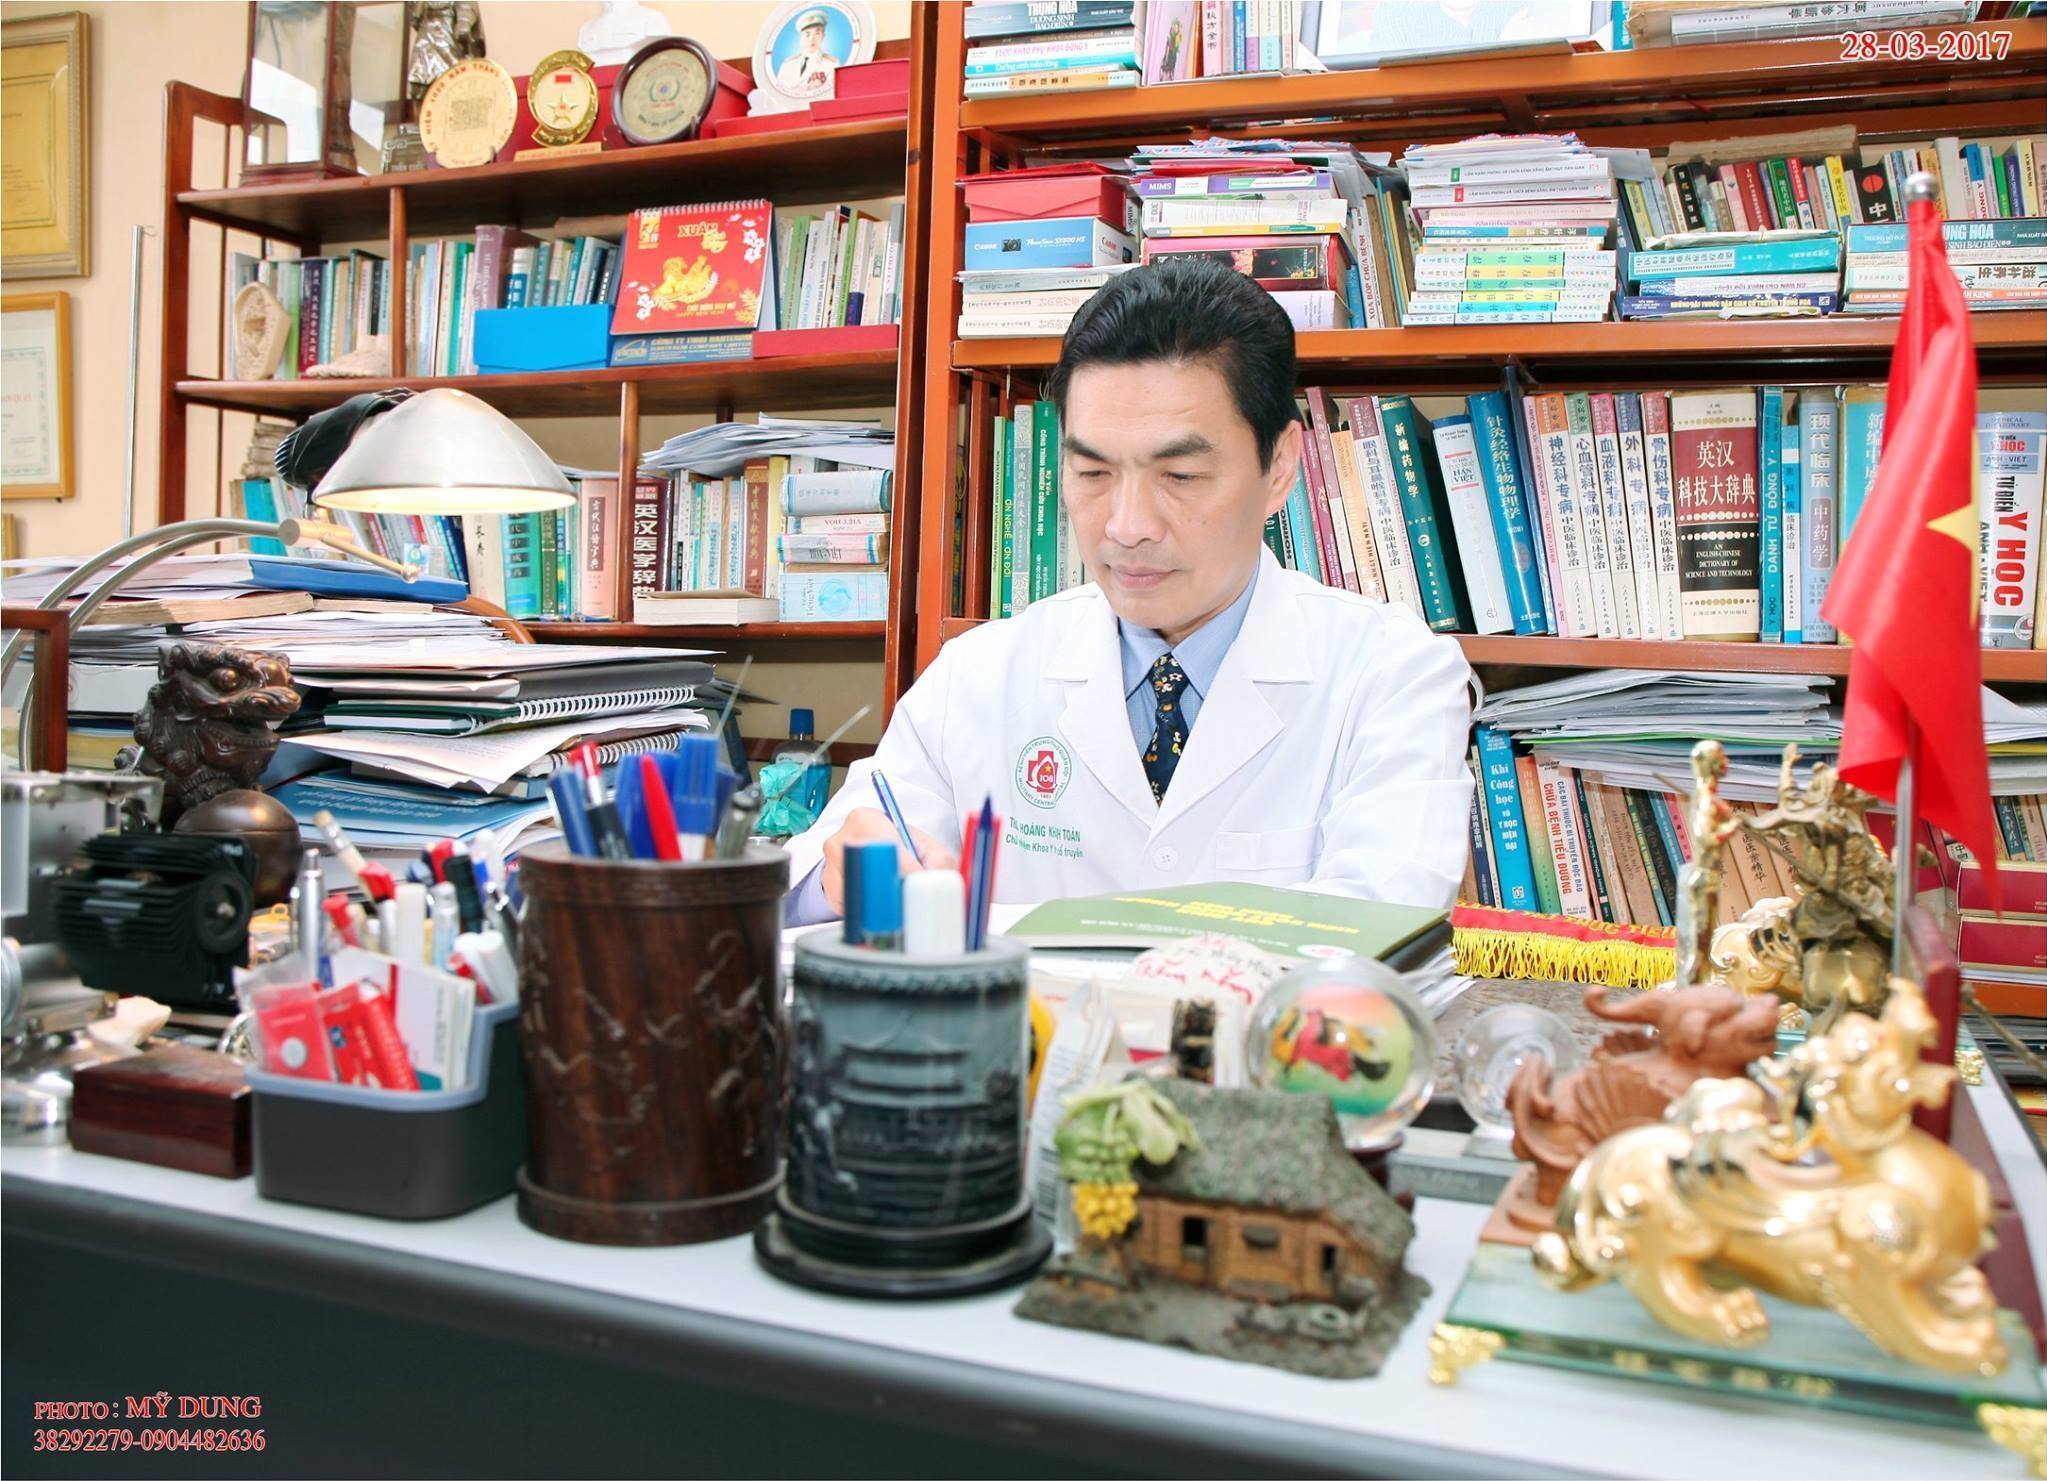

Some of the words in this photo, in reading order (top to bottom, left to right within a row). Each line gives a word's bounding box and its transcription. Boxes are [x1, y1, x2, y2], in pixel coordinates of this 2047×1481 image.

[1028, 2, 1057, 17] TRUNG
[1059, 1, 1078, 14] HOA
[1149, 181, 1172, 191] MIMS
[678, 221, 718, 238] XUÂN
[1943, 225, 1967, 240] UNG
[1968, 223, 1994, 239] HOA
[1696, 440, 1734, 470] 英汉
[1809, 412, 1831, 489] 现代临床
[1394, 423, 1420, 498] 新编药物学
[1768, 457, 1776, 467] Y
[1454, 474, 1474, 483] VIỆT
[1548, 437, 1573, 514] 神经科专病
[1576, 437, 1600, 517] 心血管科专病
[1600, 437, 1623, 517] 血液科专病
[1651, 437, 1672, 519] 骨伤科专病
[1678, 472, 1756, 508] 科技大辞典
[1766, 473, 1778, 511] ĐÔNG
[1994, 490, 2020, 513] ĐIỂN
[1766, 515, 1778, 534] TỪ
[1998, 512, 2028, 531] Y
[1281, 509, 1292, 560] HORMO
[1812, 503, 1829, 561] 中药学
[1696, 550, 1741, 558] ENGLISH-CHINESE
[1699, 560, 1729, 568] DICTIONARY
[1731, 559, 1738, 567] OF
[1768, 543, 1779, 574] DANH
[1685, 571, 1706, 579] SCIENCE
[1707, 570, 1718, 578] AND
[1719, 568, 1753, 578] TECHNOLOGY
[1991, 539, 2027, 607] HỌC
[1768, 596, 1777, 613] HỌC
[1040, 774, 1053, 783] 108
[1490, 764, 1509, 776] Khí
[1490, 779, 1515, 791] Công
[1495, 793, 1514, 805] học
[1544, 783, 1557, 808] CHỮA
[1557, 781, 1567, 794] CÁC
[1562, 808, 1574, 829] THUỐC
[1504, 820, 1518, 829] HỌC
[1547, 811, 1562, 836] BỆNH
[1063, 828, 1081, 842] TOÀN
[1502, 830, 1518, 840] HIỆN
[1032, 842, 1049, 854] Khoa
[1064, 847, 1084, 860] truyền
[1553, 839, 1568, 860] TIỂU
[1558, 863, 1572, 895] ĐƯỜNG
